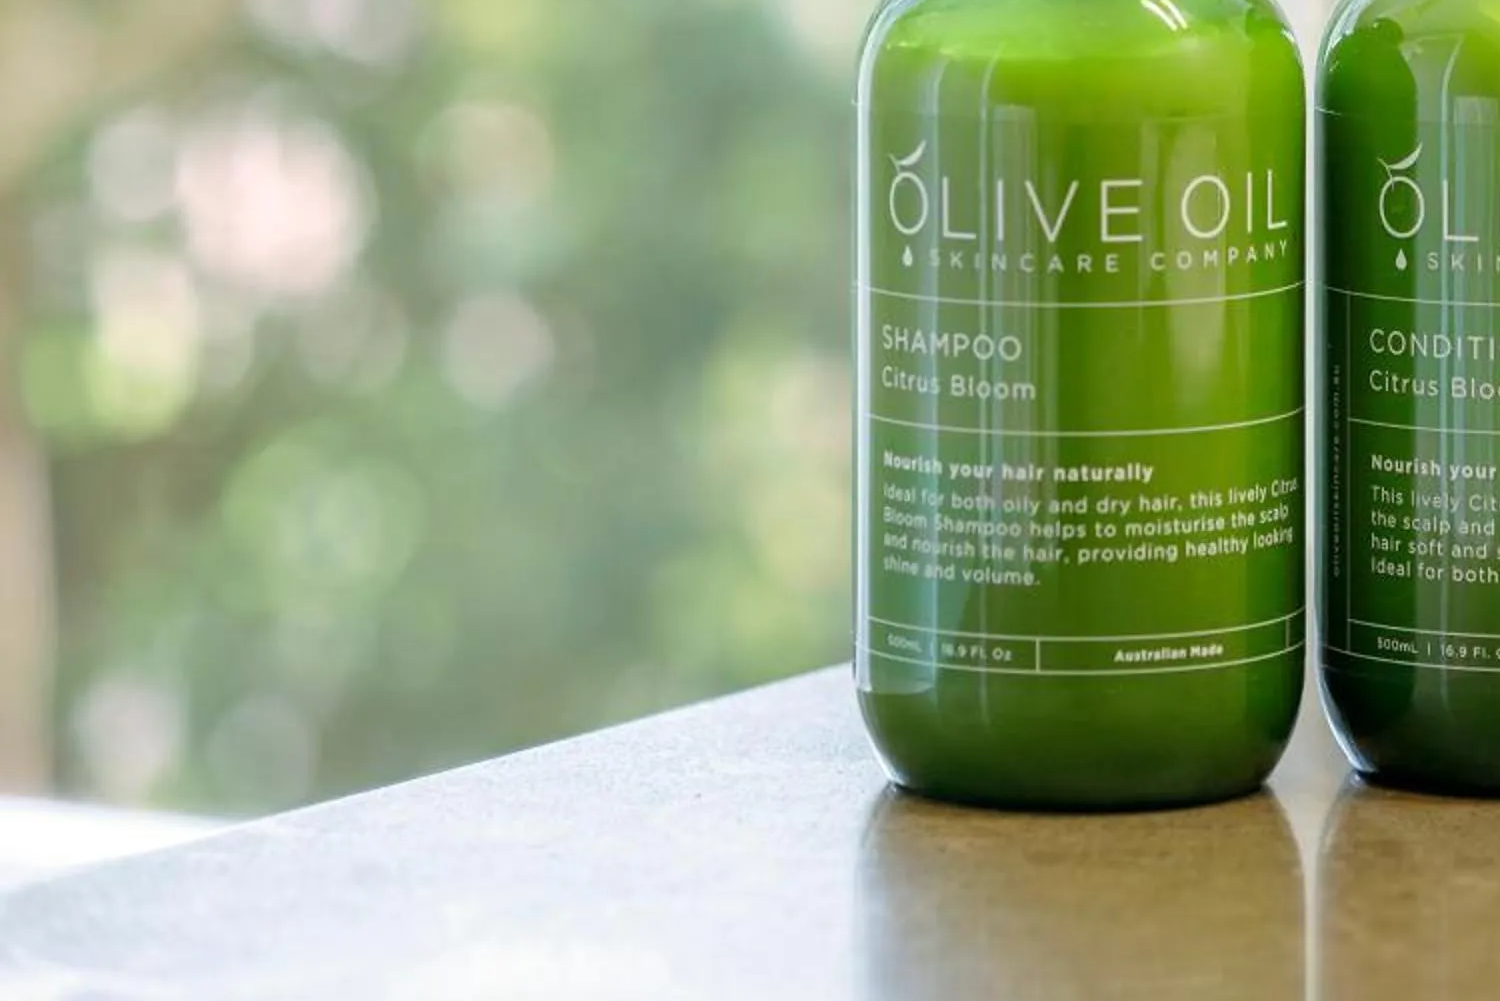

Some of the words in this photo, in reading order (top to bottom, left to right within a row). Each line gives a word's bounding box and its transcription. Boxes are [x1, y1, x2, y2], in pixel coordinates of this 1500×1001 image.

[889, 170, 1143, 243] OLIVE
[1181, 167, 1289, 239] OIL
[928, 247, 1119, 274] SKINCARE
[1150, 238, 1288, 272] COMPANY
[882, 324, 1022, 361] SHAMPOO
[882, 365, 941, 395] Citrus
[951, 374, 1037, 400] Bloom
[1368, 369, 1440, 398] Citrus
[883, 451, 943, 474] Nourish
[949, 463, 993, 481] your
[1002, 462, 1044, 481] hair
[1053, 462, 1154, 484] naturally
[1370, 454, 1442, 477] Nourish
[1449, 464, 1497, 481] your
[951, 492, 995, 511] both
[1048, 496, 1088, 514] and
[1096, 496, 1131, 517] dry
[1190, 490, 1222, 508] this
[1228, 482, 1267, 504] lively
[1370, 485, 1404, 505] This
[1410, 491, 1465, 513] lively
[883, 506, 927, 528] Bloom
[935, 513, 1022, 539] Shampoo
[1029, 521, 1086, 540] helps
[1095, 522, 1117, 538] to
[1125, 514, 1225, 537] moisturise
[1370, 510, 1398, 529] the
[1402, 515, 1451, 535] scalp
[1457, 519, 1496, 536] and
[912, 537, 975, 559] nourish
[981, 543, 1015, 561] the
[1077, 543, 1179, 565] providing
[1185, 535, 1249, 558] healthy
[1370, 533, 1402, 552] hair
[1407, 539, 1444, 557] soft
[1451, 542, 1487, 560] and
[923, 563, 955, 581] and
[1370, 557, 1412, 577] Ideal
[1452, 566, 1499, 583] both
[1113, 646, 1187, 664] Australian
[1189, 642, 1225, 658] Made
[1376, 636, 1420, 654] 500mL
[1440, 643, 1467, 659] 16.9
